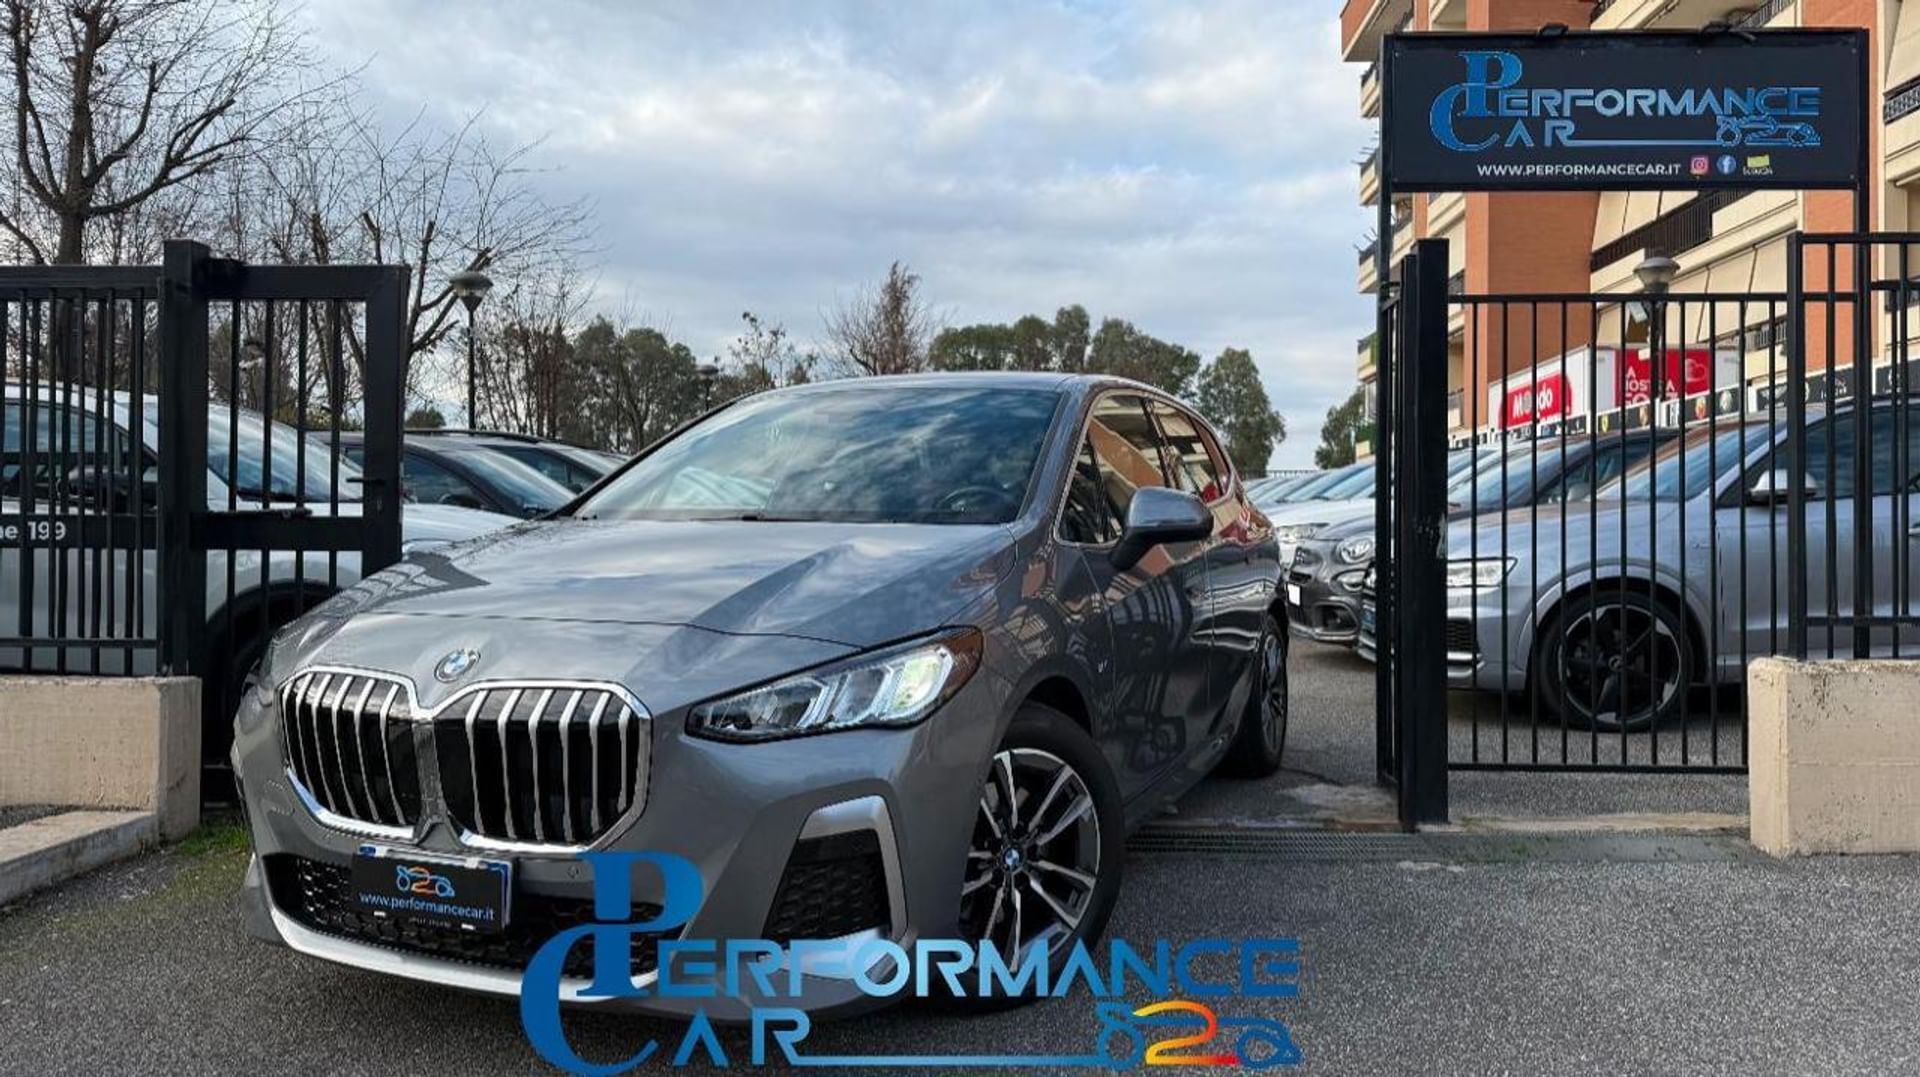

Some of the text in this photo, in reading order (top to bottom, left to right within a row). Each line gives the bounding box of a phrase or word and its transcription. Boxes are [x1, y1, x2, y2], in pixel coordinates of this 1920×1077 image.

[1457, 50, 1822, 117] PERFORMANCE
[1429, 83, 1576, 151] CAR
[1476, 162, 1682, 178] WWW.PERFORMANCECAR.IT
[0, 521, 66, 540] e 199
[359, 892, 495, 921] www.performancecar.it
